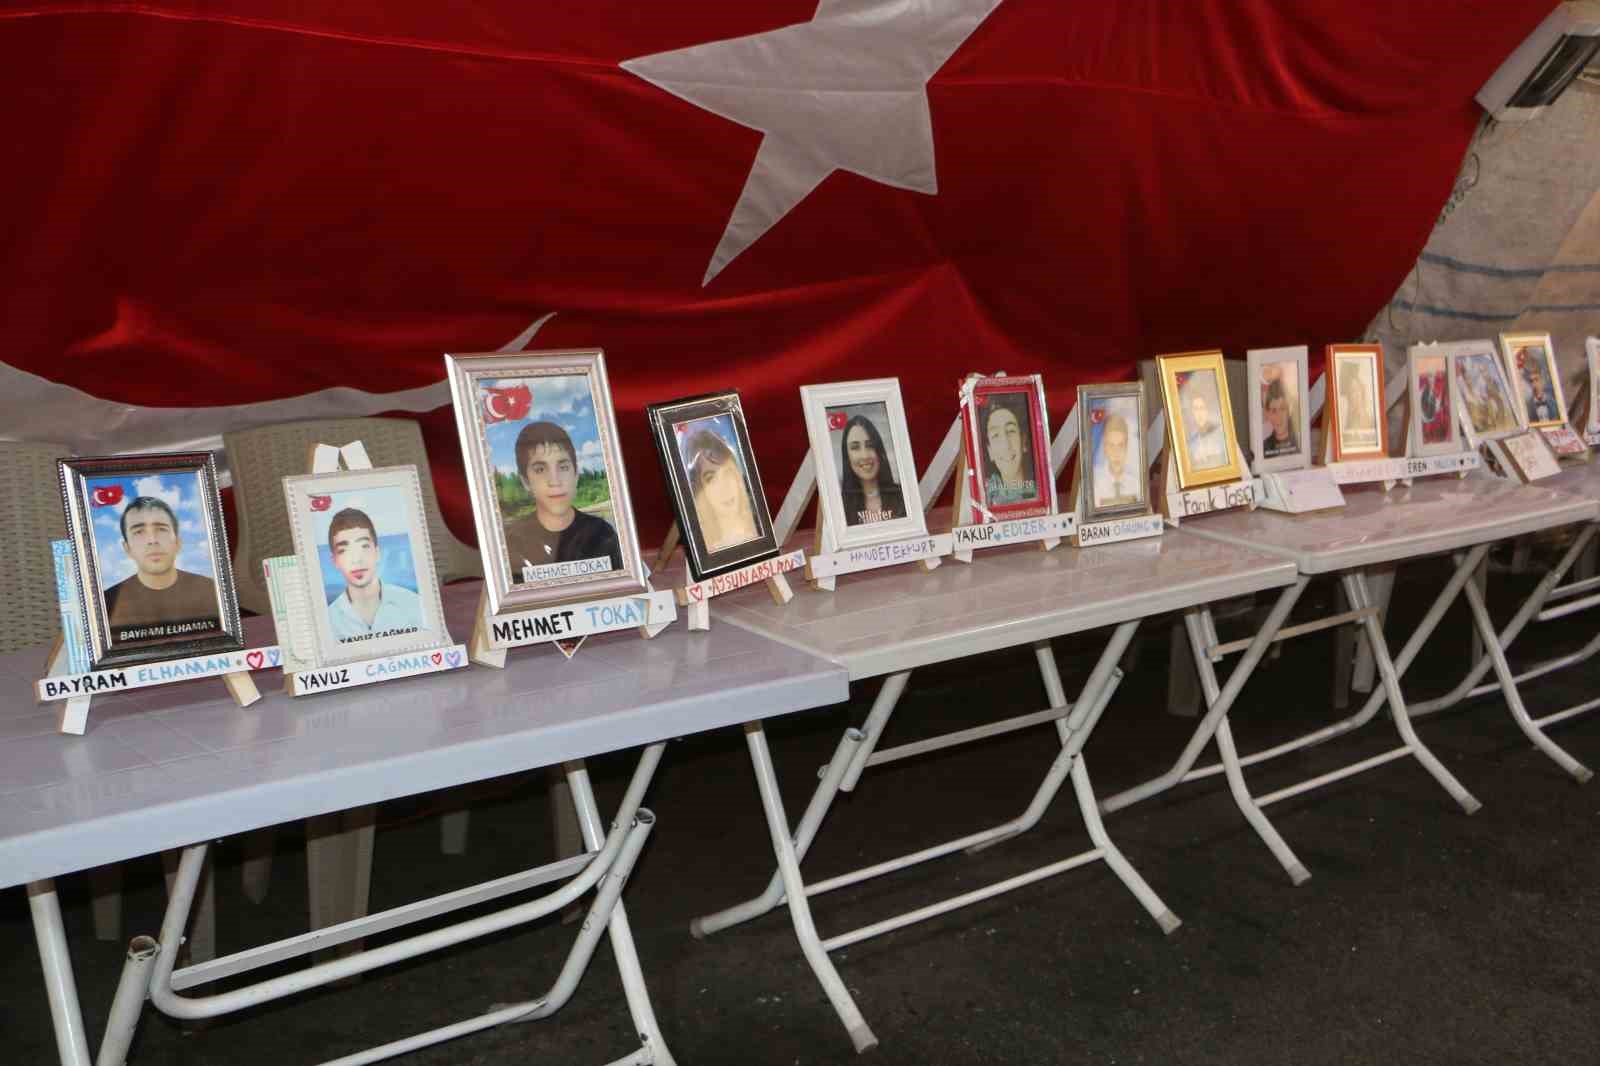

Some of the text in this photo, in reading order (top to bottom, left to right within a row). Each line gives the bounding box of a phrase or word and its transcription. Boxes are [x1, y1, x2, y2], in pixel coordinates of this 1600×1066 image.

[956, 526, 994, 543] YAKUP
[1081, 525, 1110, 542] BARAN
[526, 558, 609, 581] MEHMET TOKAY
[712, 573, 749, 597] AYSUN
[120, 620, 216, 641] BAYRAM ELHAMAN
[493, 600, 646, 642] MEHMET TOKAY
[46, 656, 231, 697] BAYRAM ELHAMAN
[299, 669, 350, 691] YAVUZ
